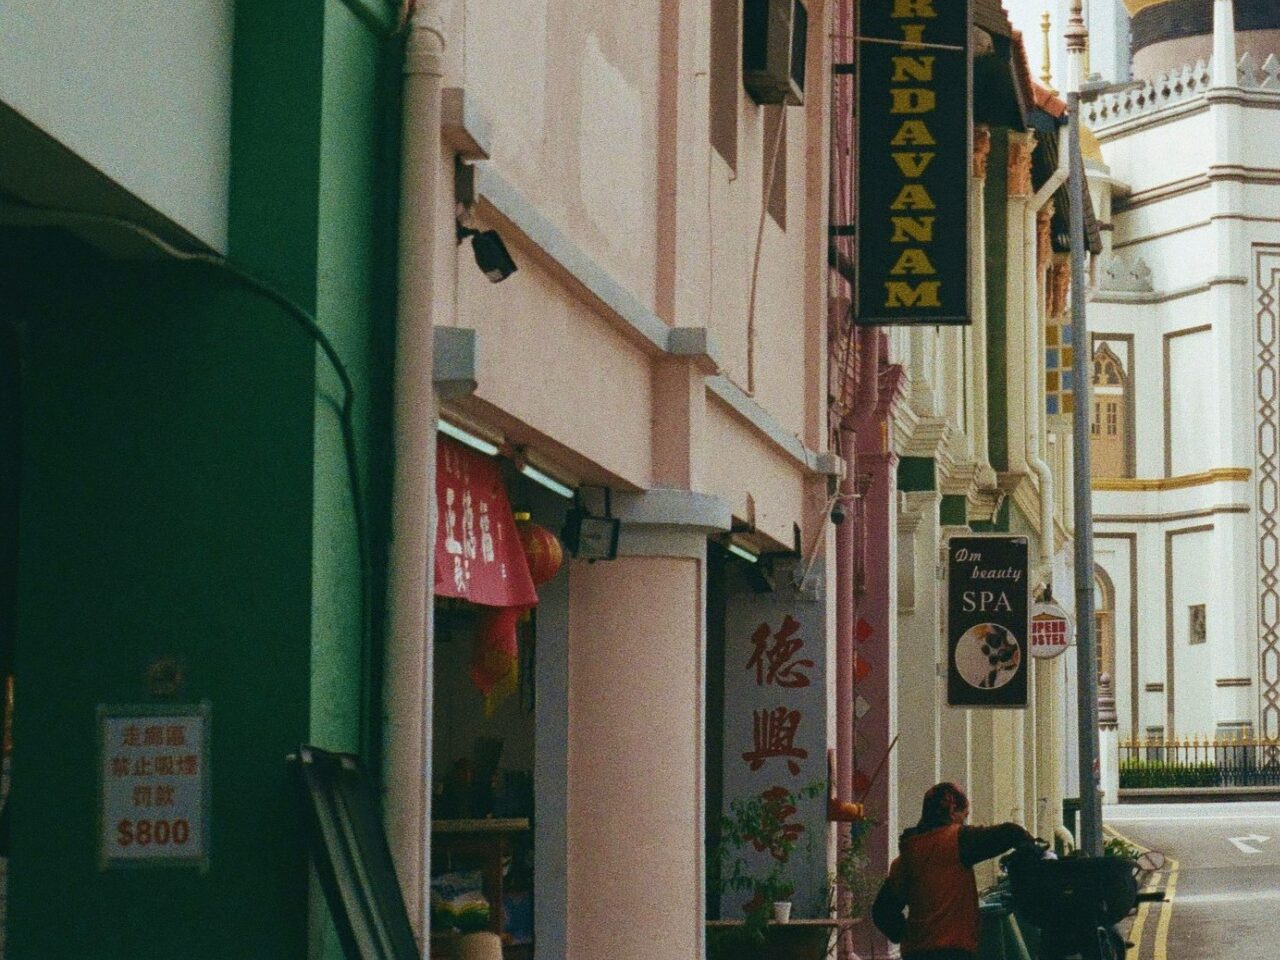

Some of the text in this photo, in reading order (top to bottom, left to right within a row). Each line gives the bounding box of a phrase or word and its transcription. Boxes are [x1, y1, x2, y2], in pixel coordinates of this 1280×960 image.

[955, 548, 982, 562] Dm
[971, 565, 1022, 582] beauty
[962, 591, 1013, 612] SPA
[1031, 634, 1067, 646] OSTEL
[117, 818, 190, 847] $800
